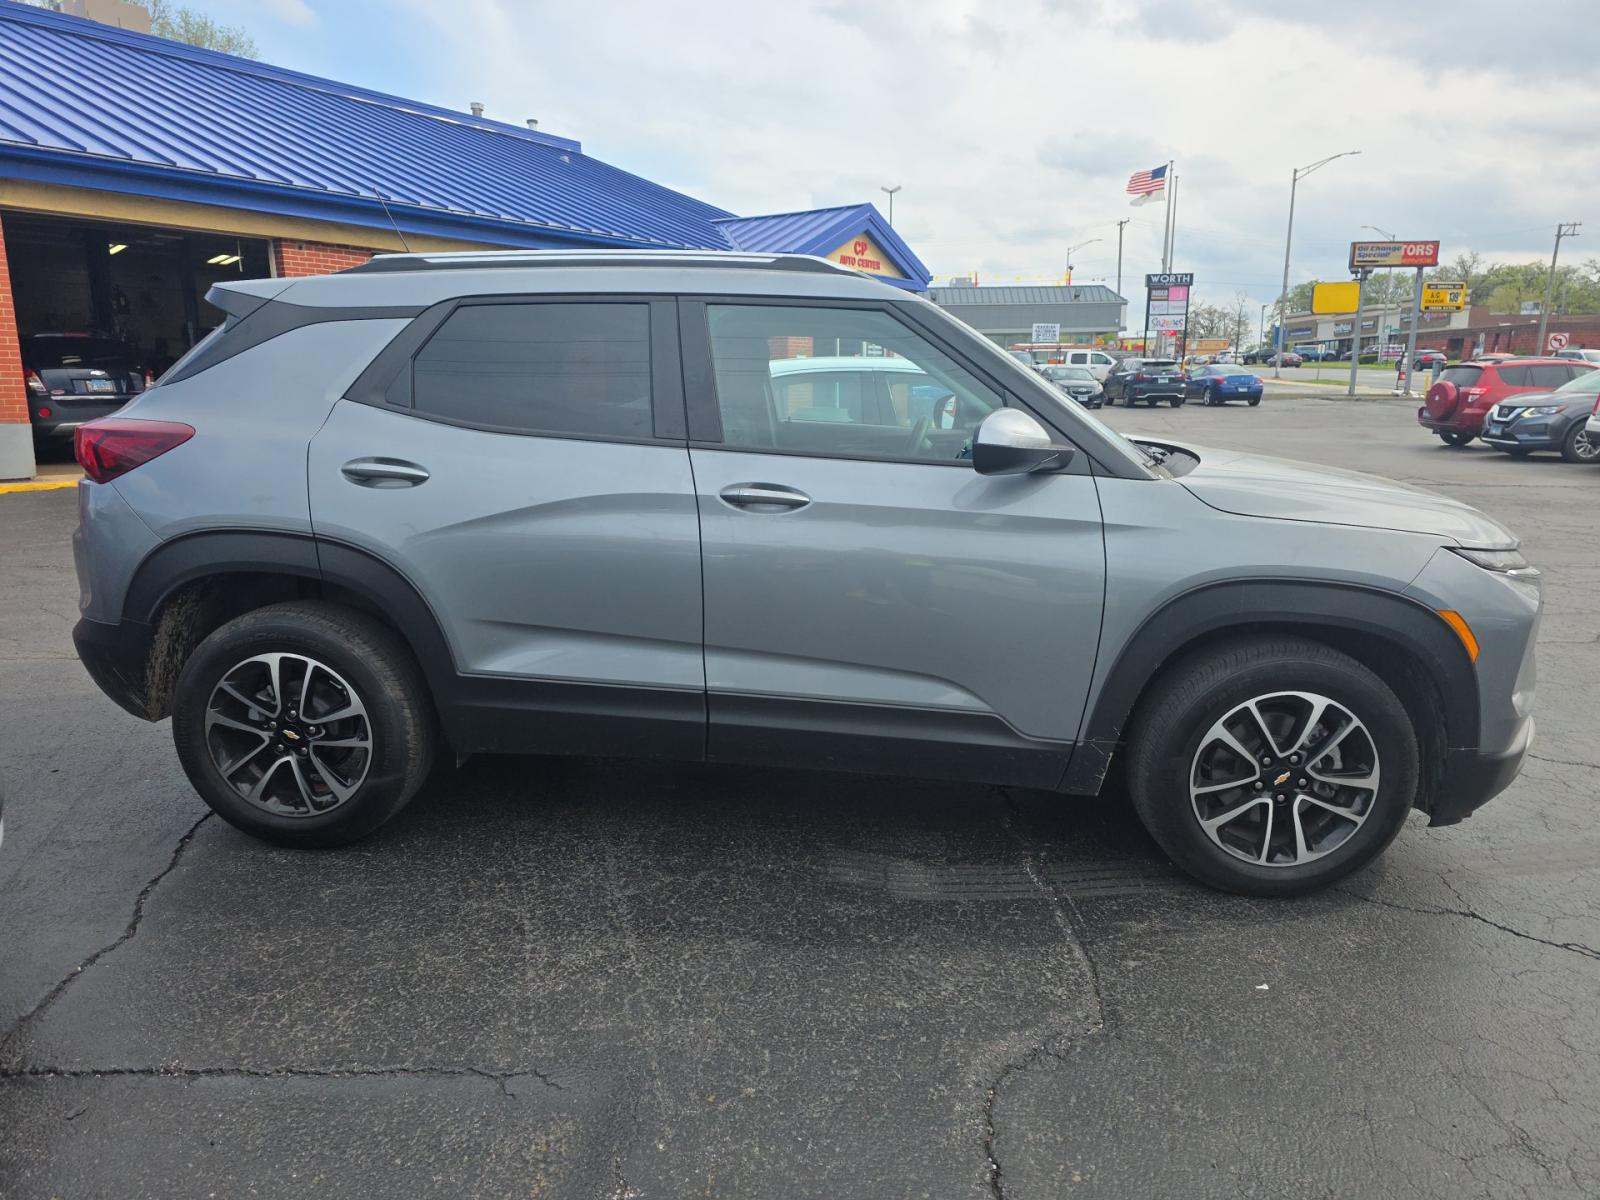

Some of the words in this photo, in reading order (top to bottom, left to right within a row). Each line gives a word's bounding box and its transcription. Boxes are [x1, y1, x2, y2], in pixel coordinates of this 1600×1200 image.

[854, 241, 867, 255] CP
[840, 255, 856, 265] AUTO
[857, 257, 880, 270] CENTER
[1151, 275, 1189, 283] WORTH
